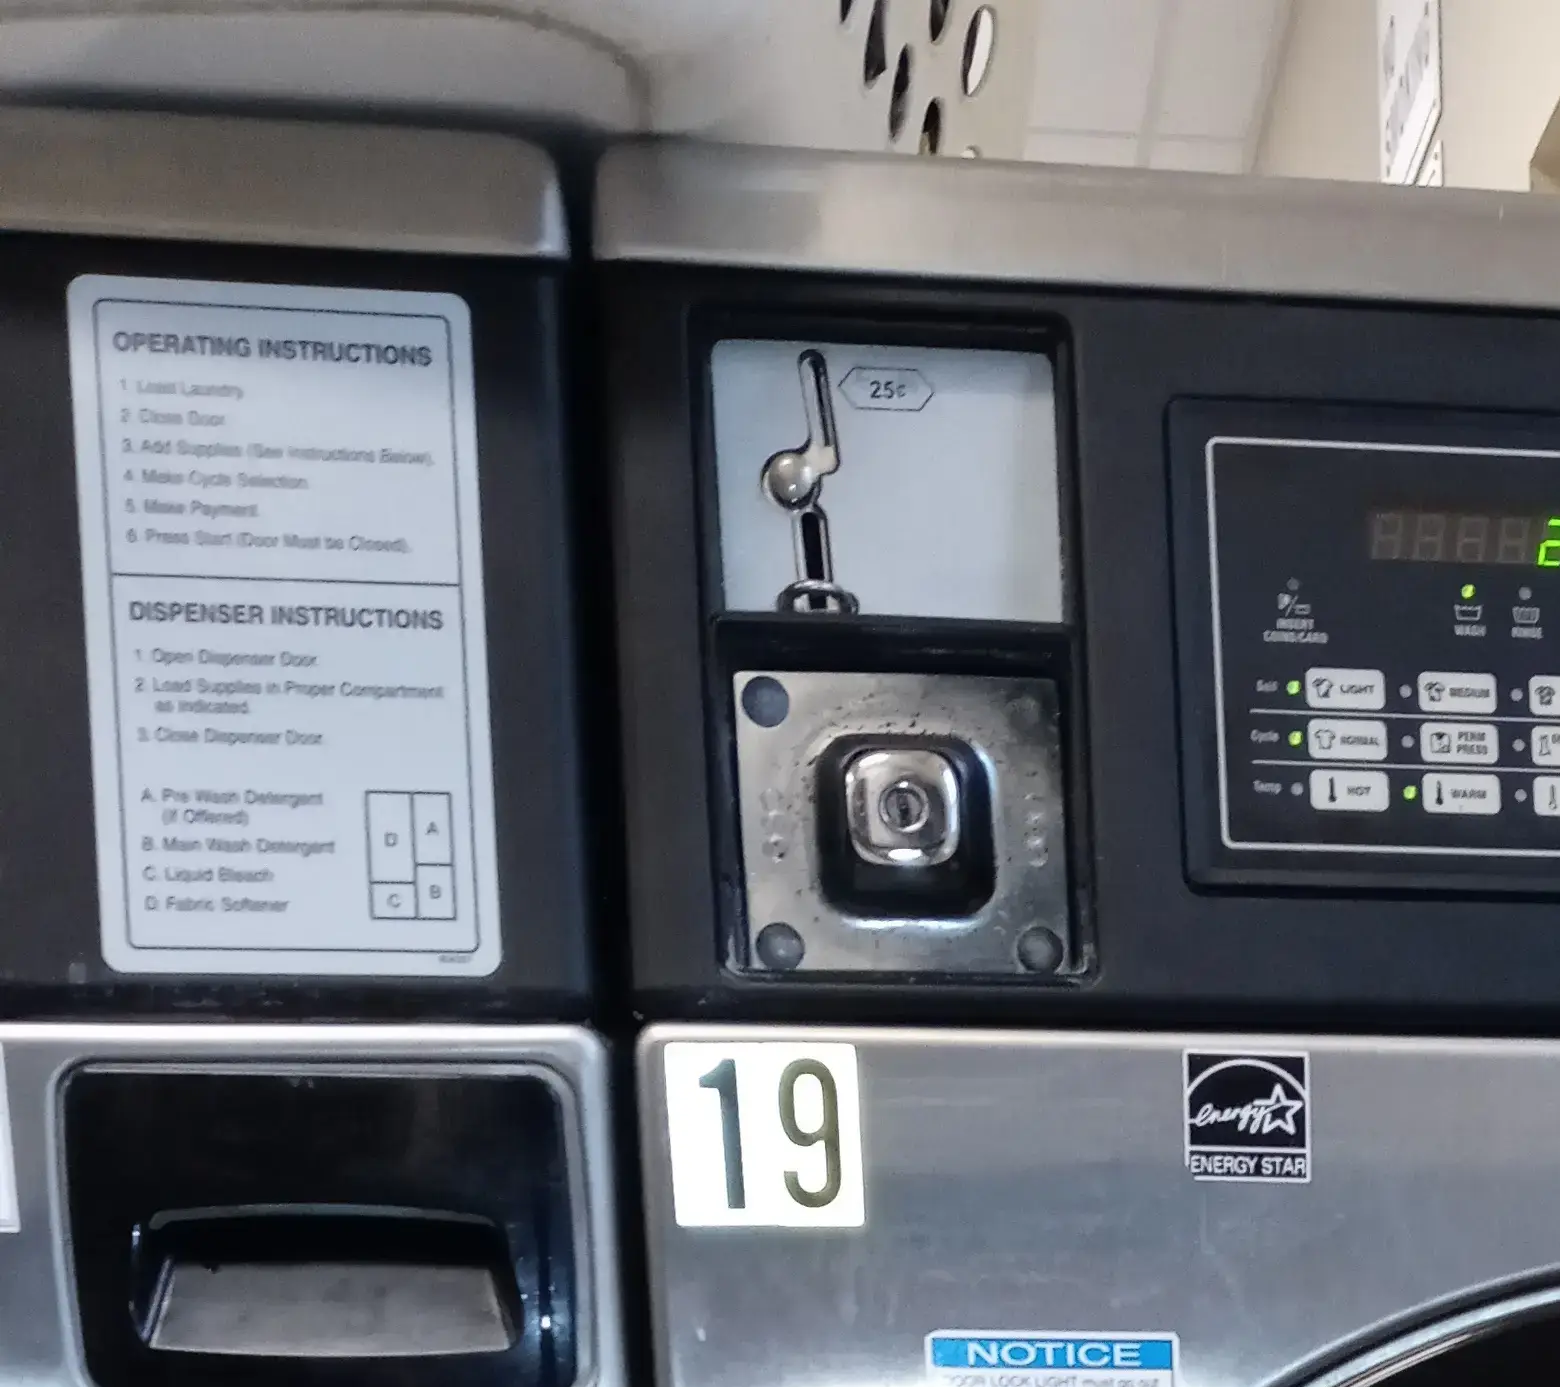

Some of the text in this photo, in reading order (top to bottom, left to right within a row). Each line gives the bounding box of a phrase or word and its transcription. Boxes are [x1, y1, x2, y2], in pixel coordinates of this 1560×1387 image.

[113, 331, 433, 367] OPERATING INSTRUCTIONS
[130, 601, 443, 630] DISPENSER INSTRUCTIONS
[1340, 685, 1375, 694] LIGHT
[1347, 786, 1371, 796] HOT
[1450, 788, 1487, 800] WARM
[427, 821, 439, 836] A
[385, 832, 397, 848] D
[429, 885, 441, 899] B
[387, 893, 401, 909] C
[699, 1058, 842, 1209] 19
[1190, 1155, 1306, 1175] ENERGY STAR
[967, 1342, 1142, 1367] NOTICE
[1034, 1375, 1077, 1387] LIGHT
